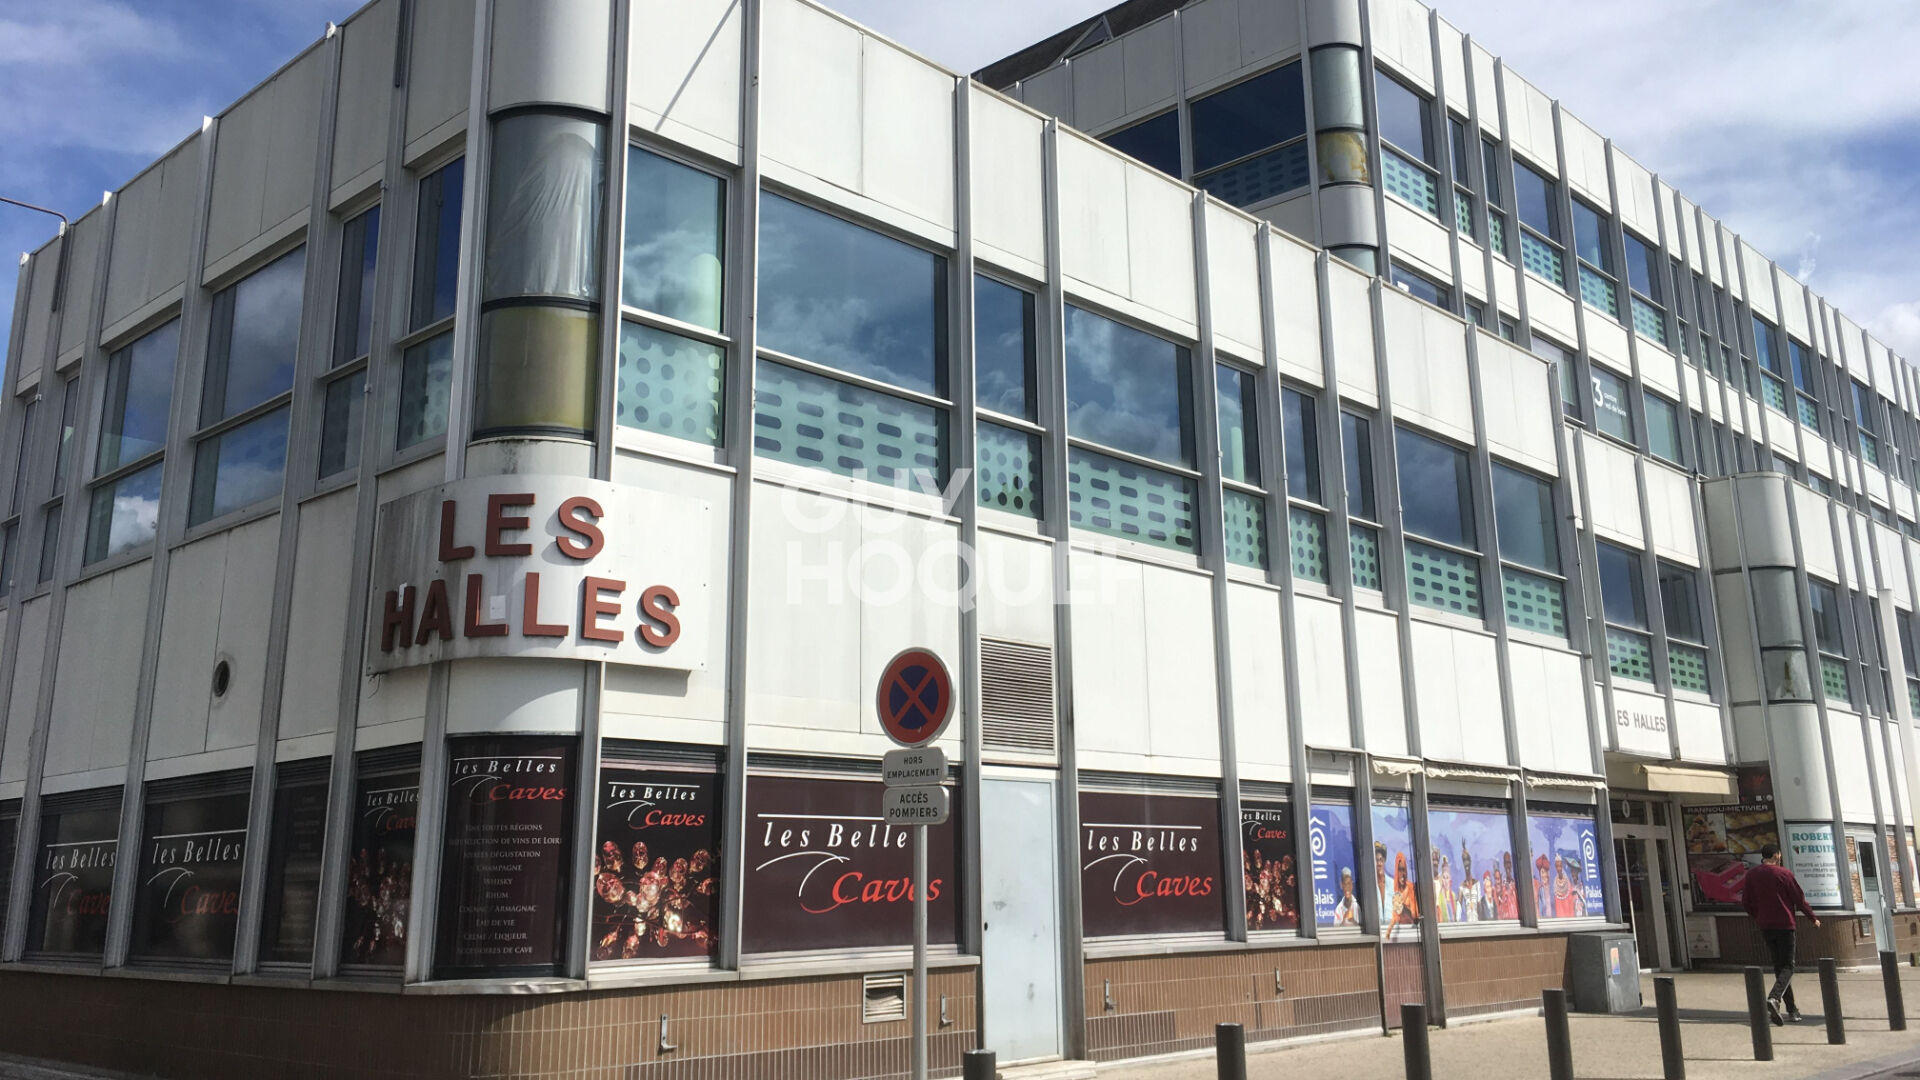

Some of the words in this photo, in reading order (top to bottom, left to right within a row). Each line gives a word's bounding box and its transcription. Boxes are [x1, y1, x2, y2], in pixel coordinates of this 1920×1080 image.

[438, 493, 605, 561] LES
[381, 572, 681, 650] HALLES
[1616, 709, 1630, 727] ES
[1633, 712, 1666, 732] HALLES
[455, 761, 478, 774] les
[487, 759, 557, 773] Belles
[903, 755, 923, 765] HORS
[887, 768, 940, 779] EMPLACEMENT
[489, 783, 568, 801] Caves
[611, 785, 635, 799] les
[643, 786, 697, 801] Belles
[900, 791, 929, 804] ACCÈS
[644, 809, 706, 827] Caves
[889, 807, 938, 818] POMPIERS
[1255, 811, 1281, 821] Belles
[512, 837, 530, 845] VINS
[531, 837, 542, 845] DE
[763, 821, 811, 848] les
[827, 823, 908, 849] Belle
[1087, 829, 1120, 851] les
[1131, 830, 1198, 852] Belles
[1257, 827, 1287, 839] Caves
[46, 849, 65, 870] les
[70, 847, 116, 869] Belles
[152, 842, 177, 865] les
[183, 838, 241, 863] Belles
[1136, 871, 1213, 898] Caves
[1314, 888, 1335, 904] alais
[503, 919, 516, 927] VIE
